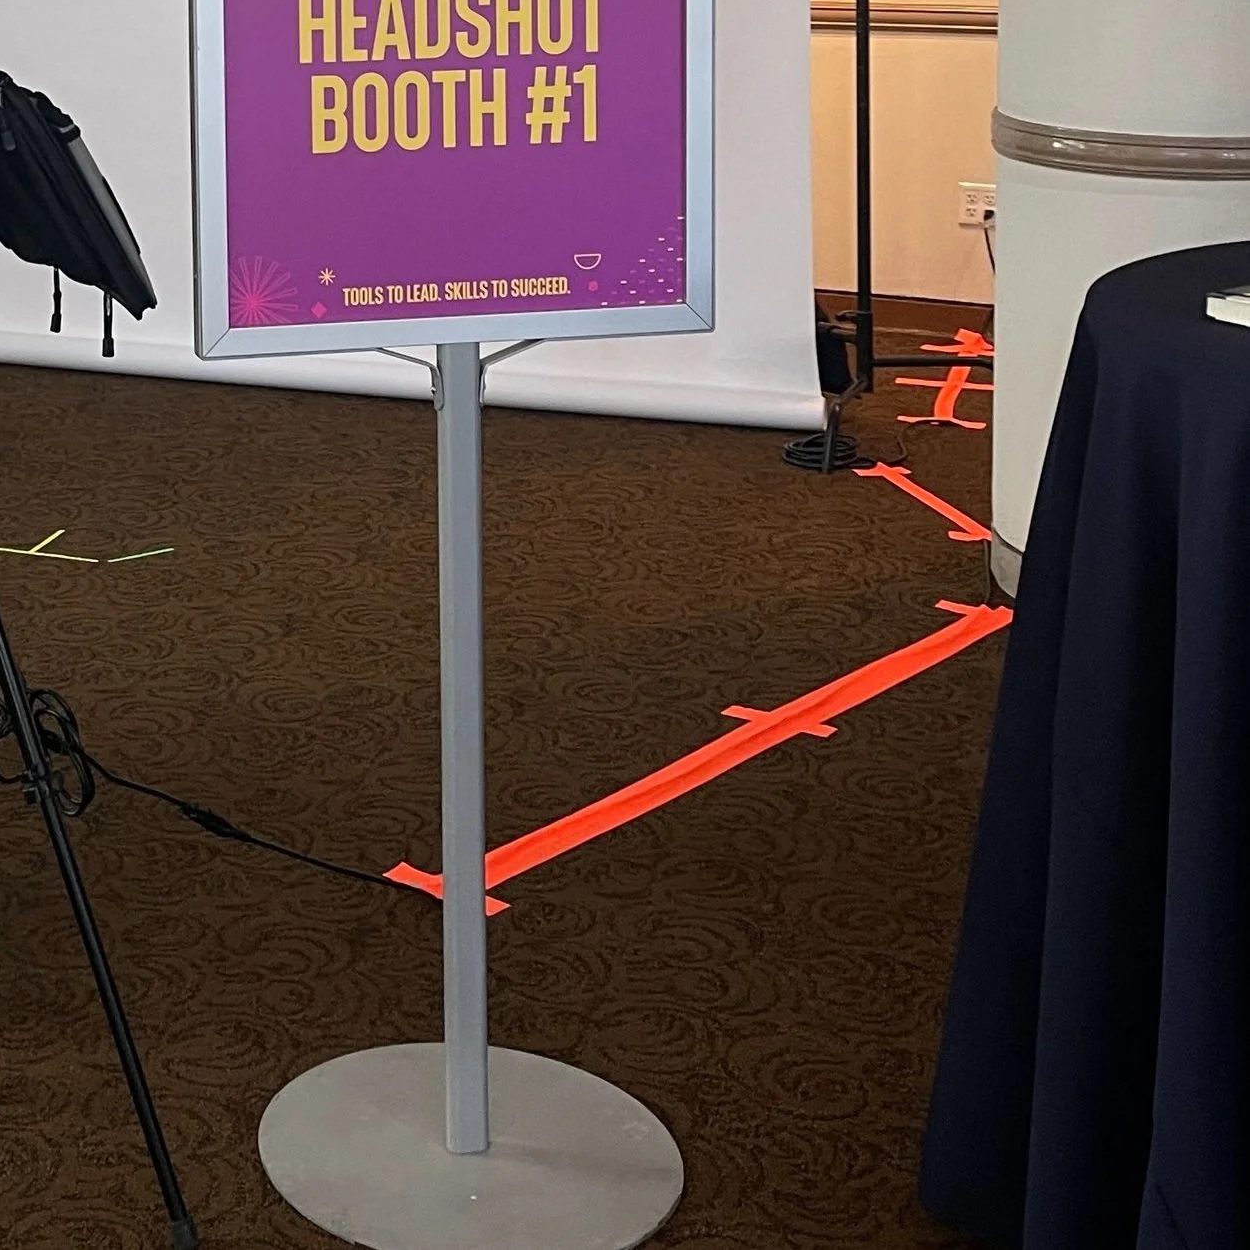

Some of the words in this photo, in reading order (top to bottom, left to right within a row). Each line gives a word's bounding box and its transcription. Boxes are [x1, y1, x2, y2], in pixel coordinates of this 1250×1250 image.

[311, 68, 507, 155] BOOTH
[525, 64, 598, 144] #1
[342, 286, 384, 306] TOOLS
[387, 285, 403, 304] TO
[406, 283, 442, 303] LEAD.
[445, 281, 488, 300] SKILLS
[491, 279, 508, 298] TO
[510, 276, 571, 297] SUCCEED.
